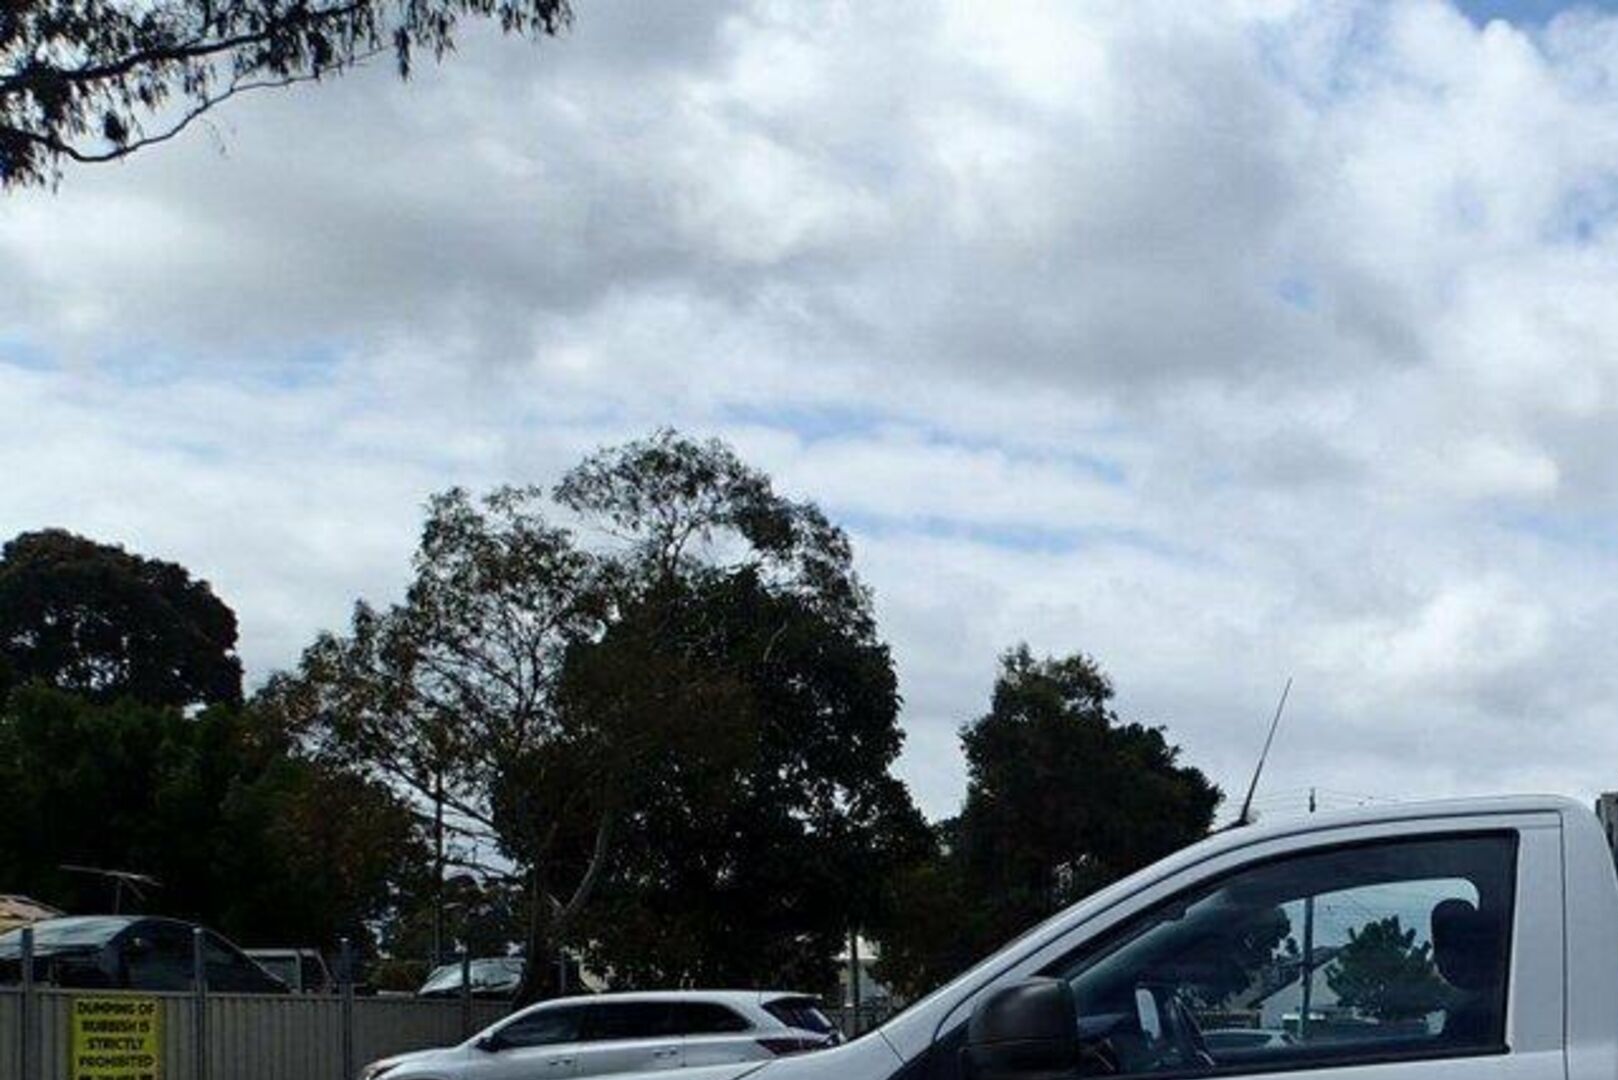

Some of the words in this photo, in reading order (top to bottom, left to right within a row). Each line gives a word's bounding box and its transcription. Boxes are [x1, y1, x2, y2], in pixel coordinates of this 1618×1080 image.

[78, 1002, 134, 1014] DUMPING
[138, 1003, 155, 1014] OF
[81, 1020, 137, 1032] RUBBISH
[139, 1020, 150, 1032] IS
[88, 1037, 144, 1050] STRICTLY
[79, 1055, 154, 1067] PROHIBITED
